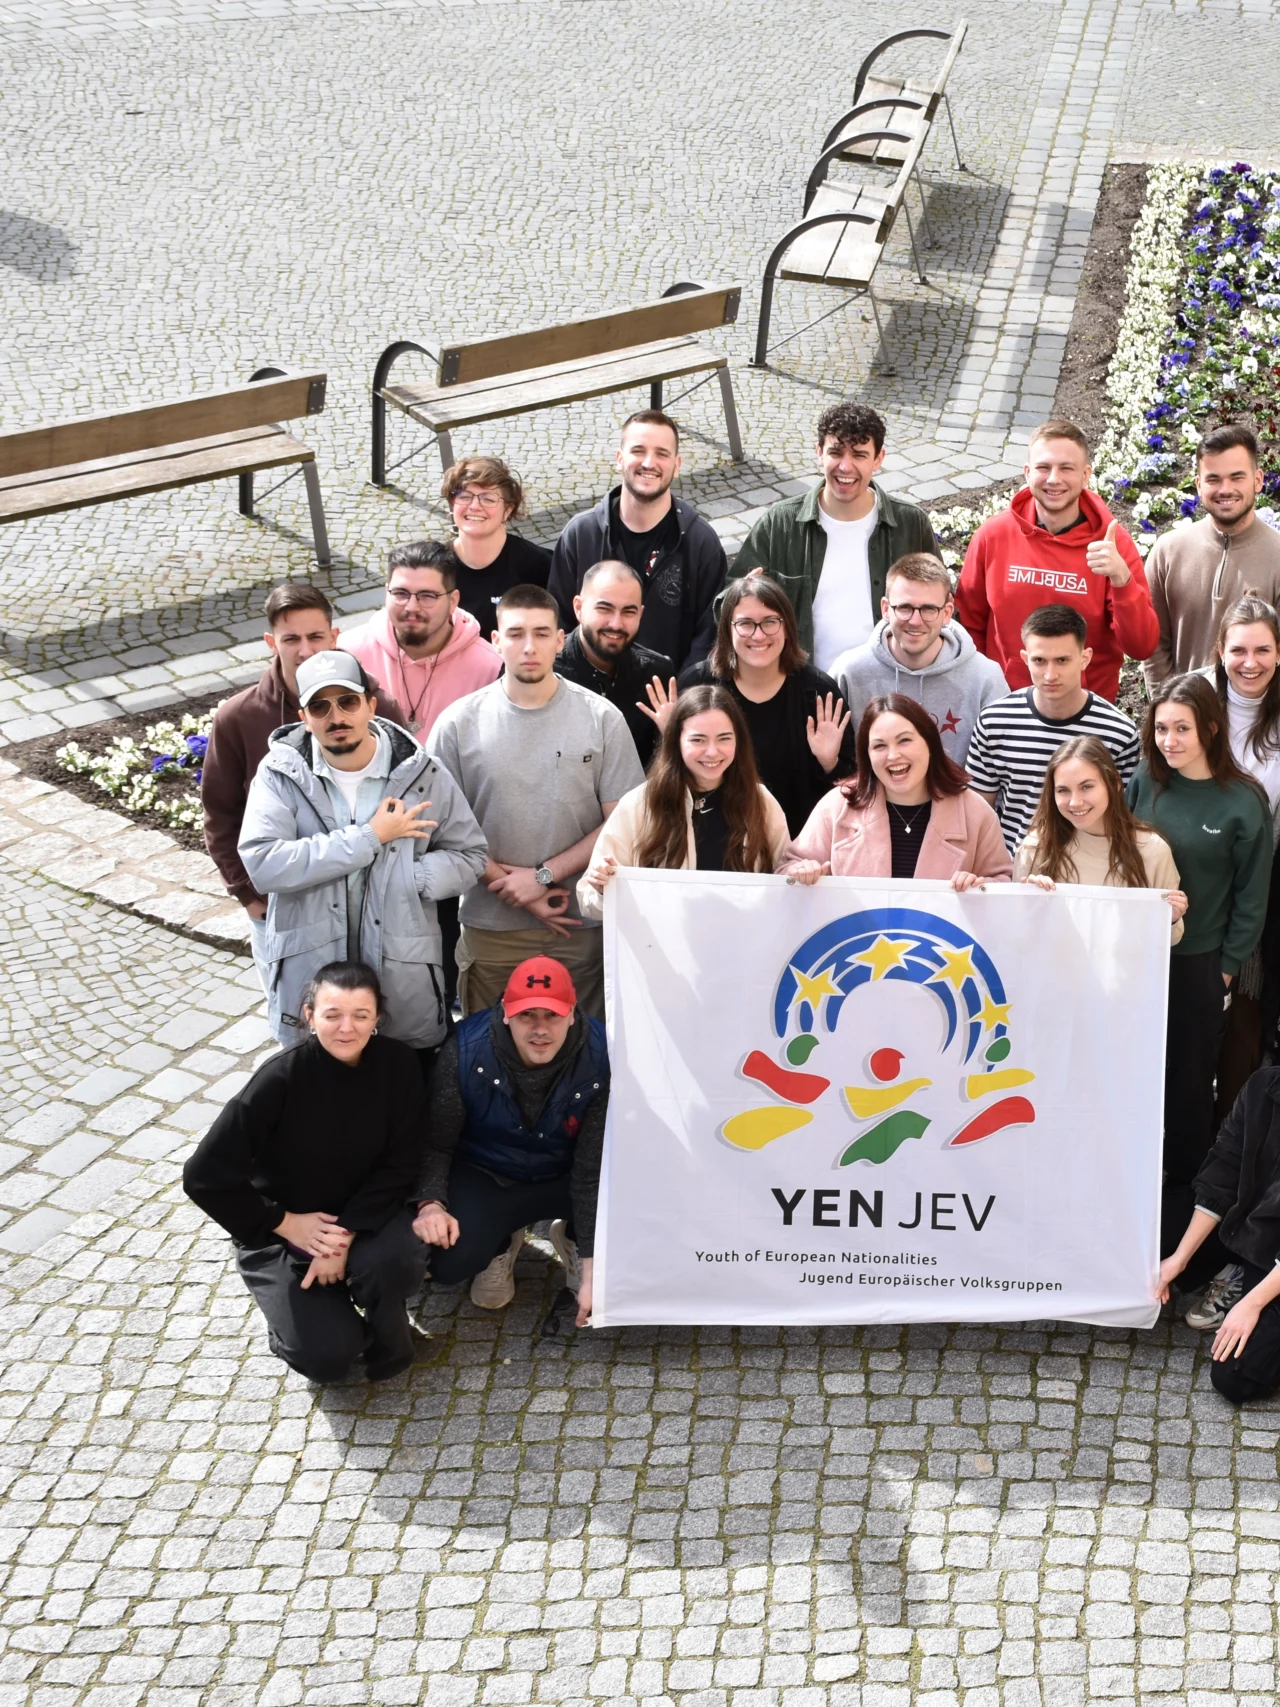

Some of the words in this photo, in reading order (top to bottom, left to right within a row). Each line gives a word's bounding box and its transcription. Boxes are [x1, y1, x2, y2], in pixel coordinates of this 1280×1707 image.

[771, 1188, 883, 1228] YEN
[898, 1192, 996, 1232] JEV
[695, 1250, 739, 1262] Youth
[745, 1250, 761, 1262] of
[765, 1251, 836, 1264] European
[841, 1252, 938, 1265] Nationalities
[799, 1272, 853, 1286] Jugend
[859, 1273, 955, 1288] Europäischer
[960, 1276, 1063, 1292] Volksgruppen
